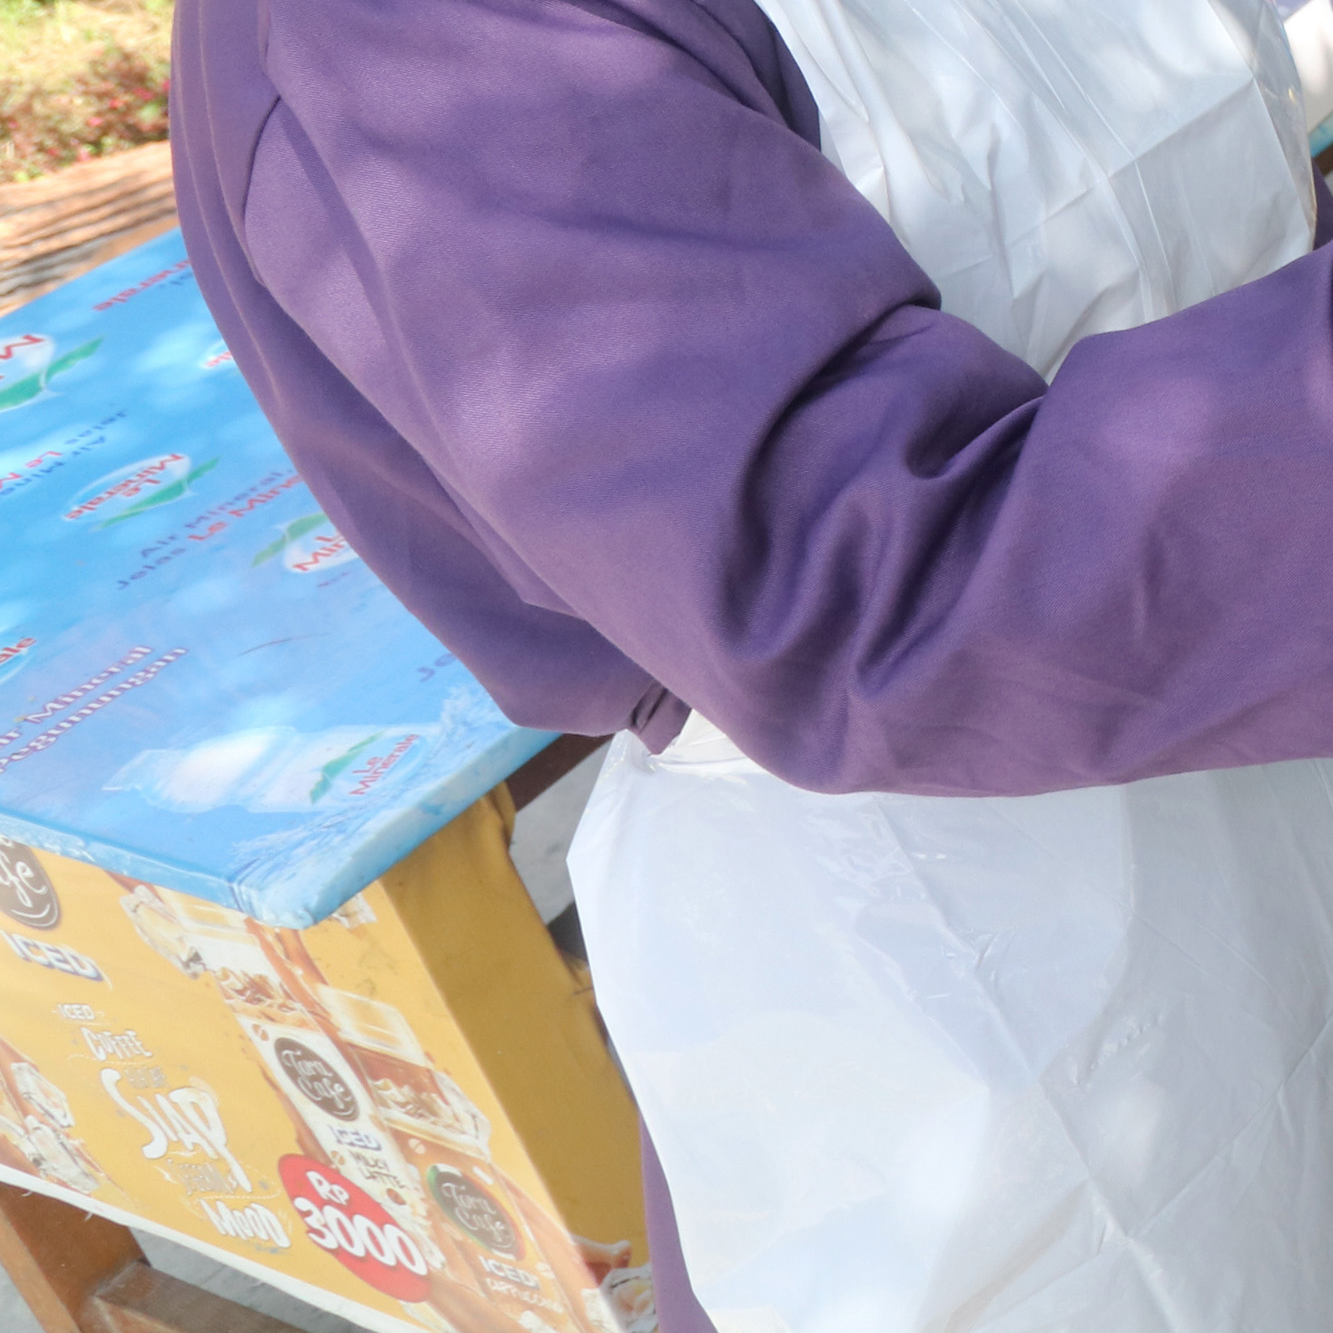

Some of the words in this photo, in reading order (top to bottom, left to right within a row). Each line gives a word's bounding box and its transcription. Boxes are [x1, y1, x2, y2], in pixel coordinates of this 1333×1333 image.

[65, 454, 184, 519] Minerale
[188, 522, 227, 541] Le
[57, 1002, 96, 1020] ICED
[294, 1197, 428, 1276] 3000
